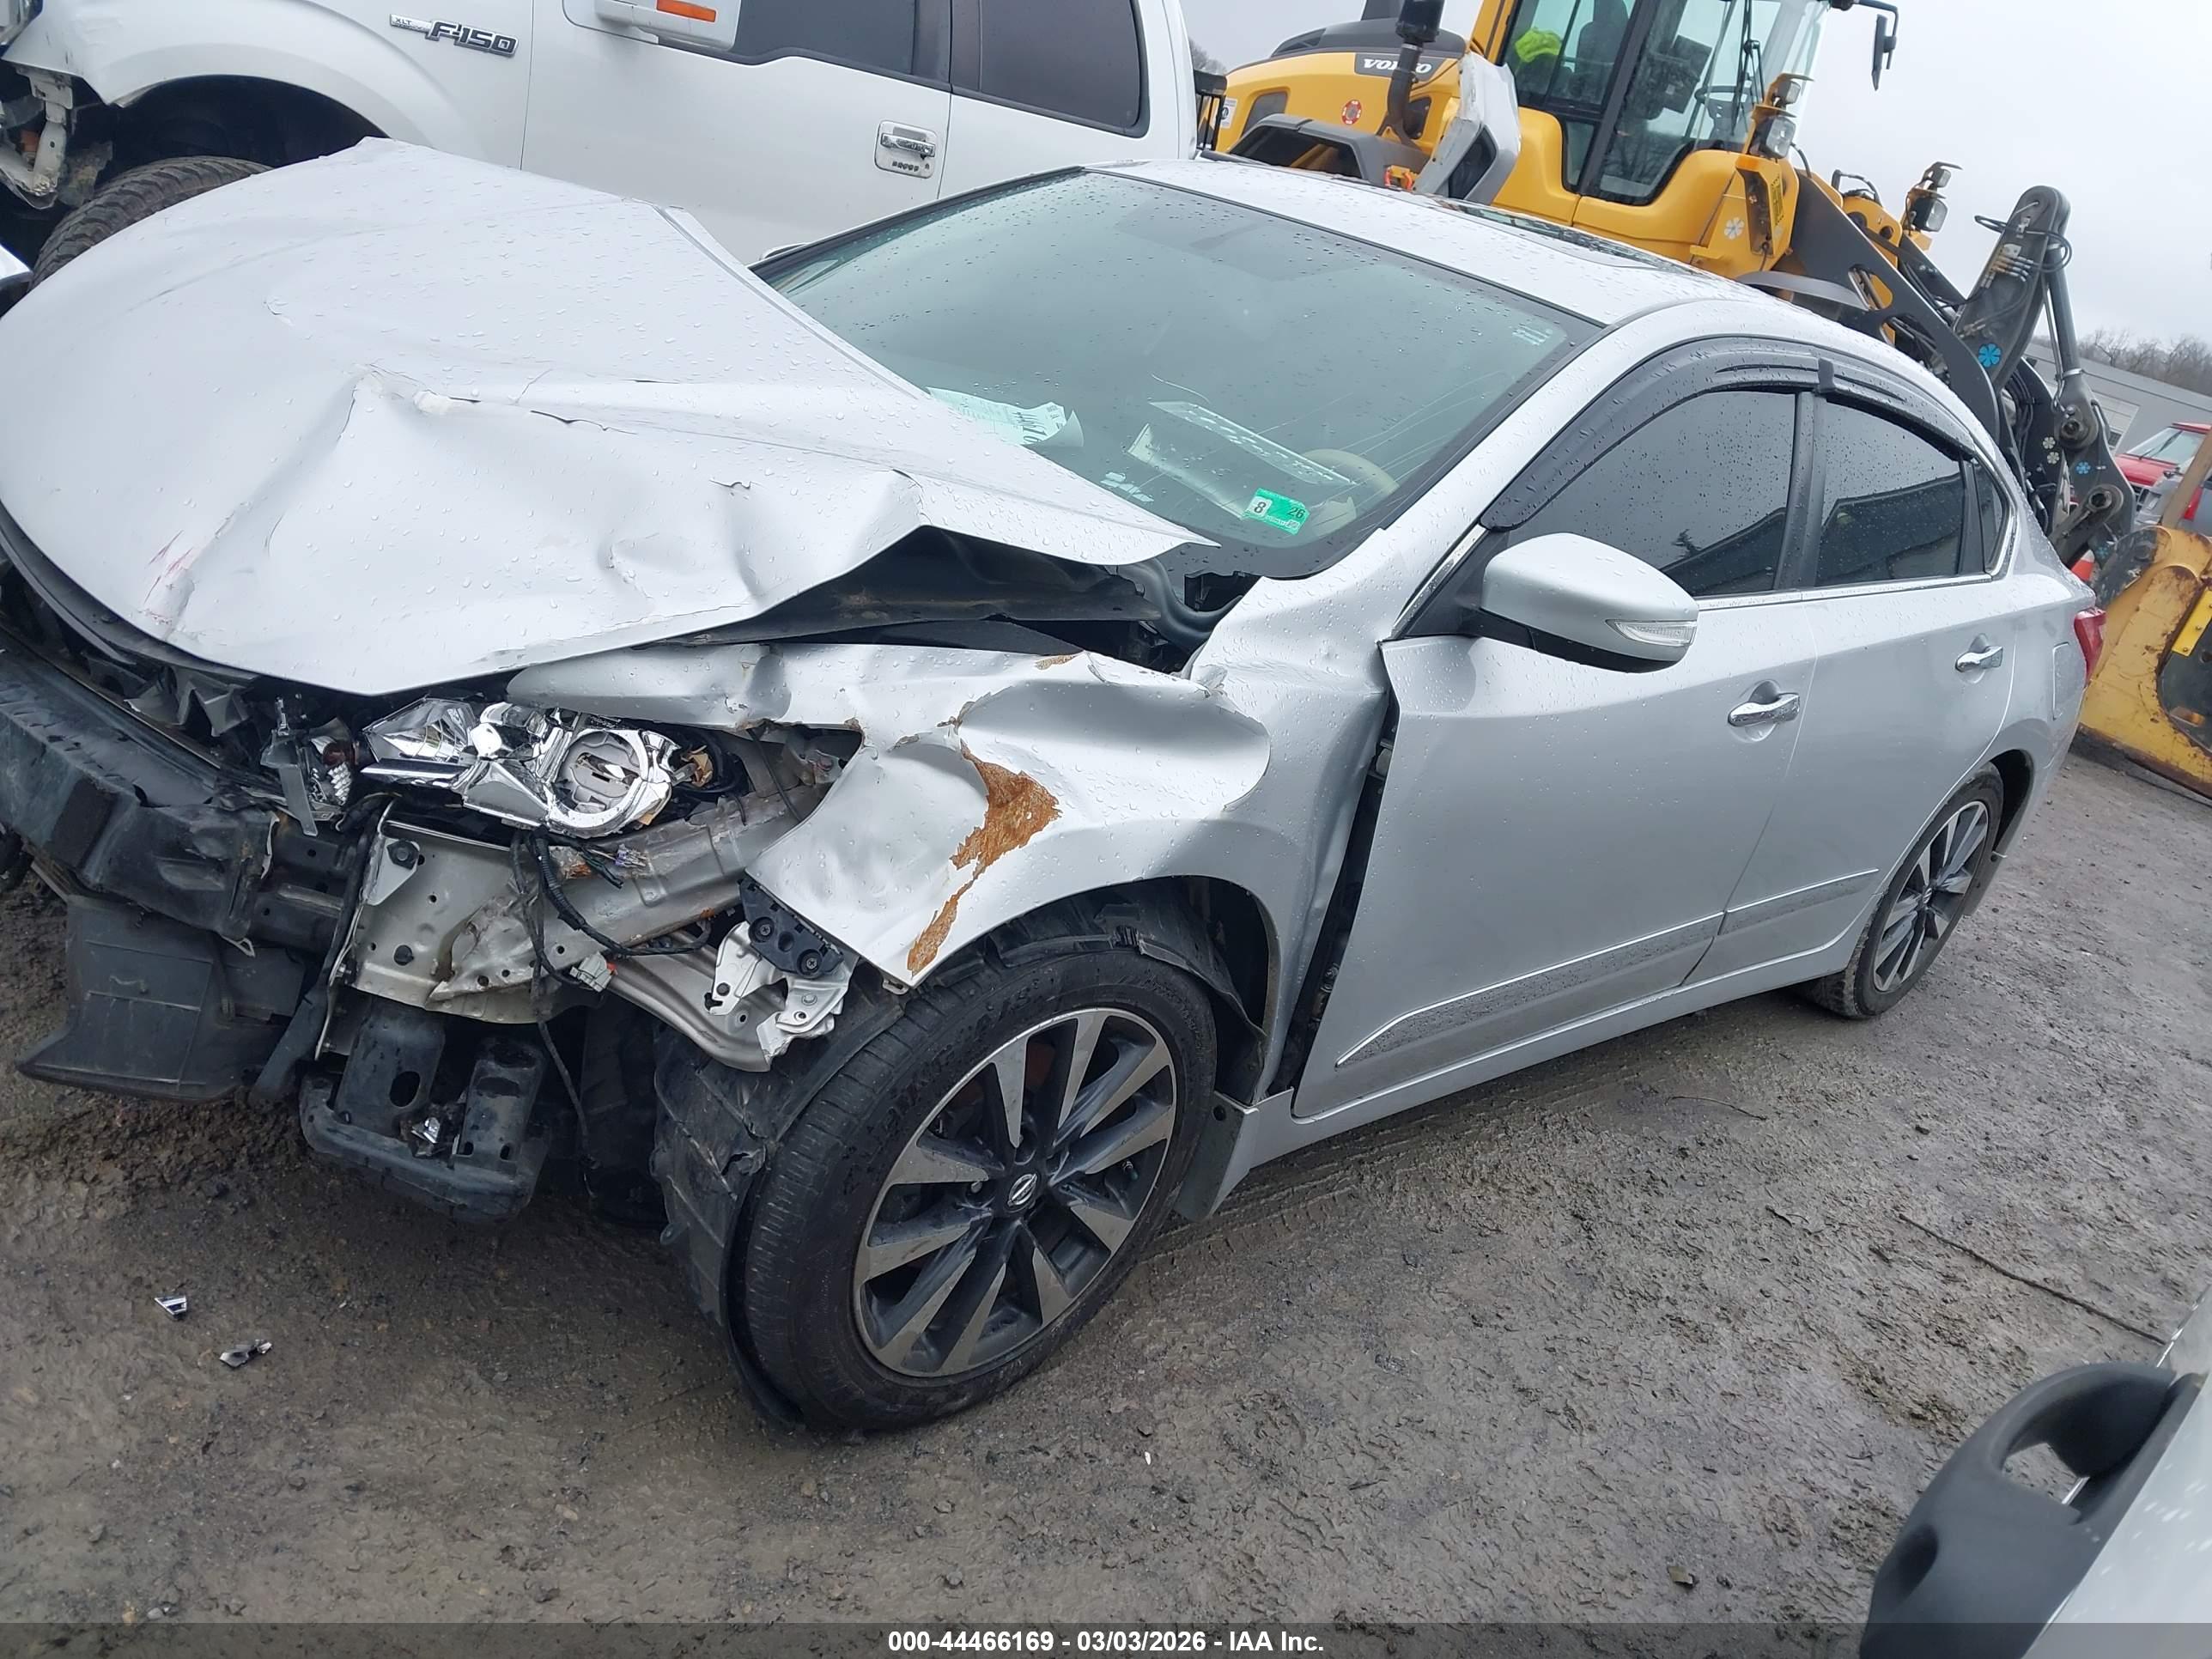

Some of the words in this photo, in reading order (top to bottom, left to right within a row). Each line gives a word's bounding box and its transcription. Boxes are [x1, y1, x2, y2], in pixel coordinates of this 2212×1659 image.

[394, 17, 412, 26] XLT
[430, 21, 517, 54] F-150
[1364, 58, 1432, 74] VOLO
[1254, 501, 1267, 514] 8
[1288, 506, 1305, 519] 26
